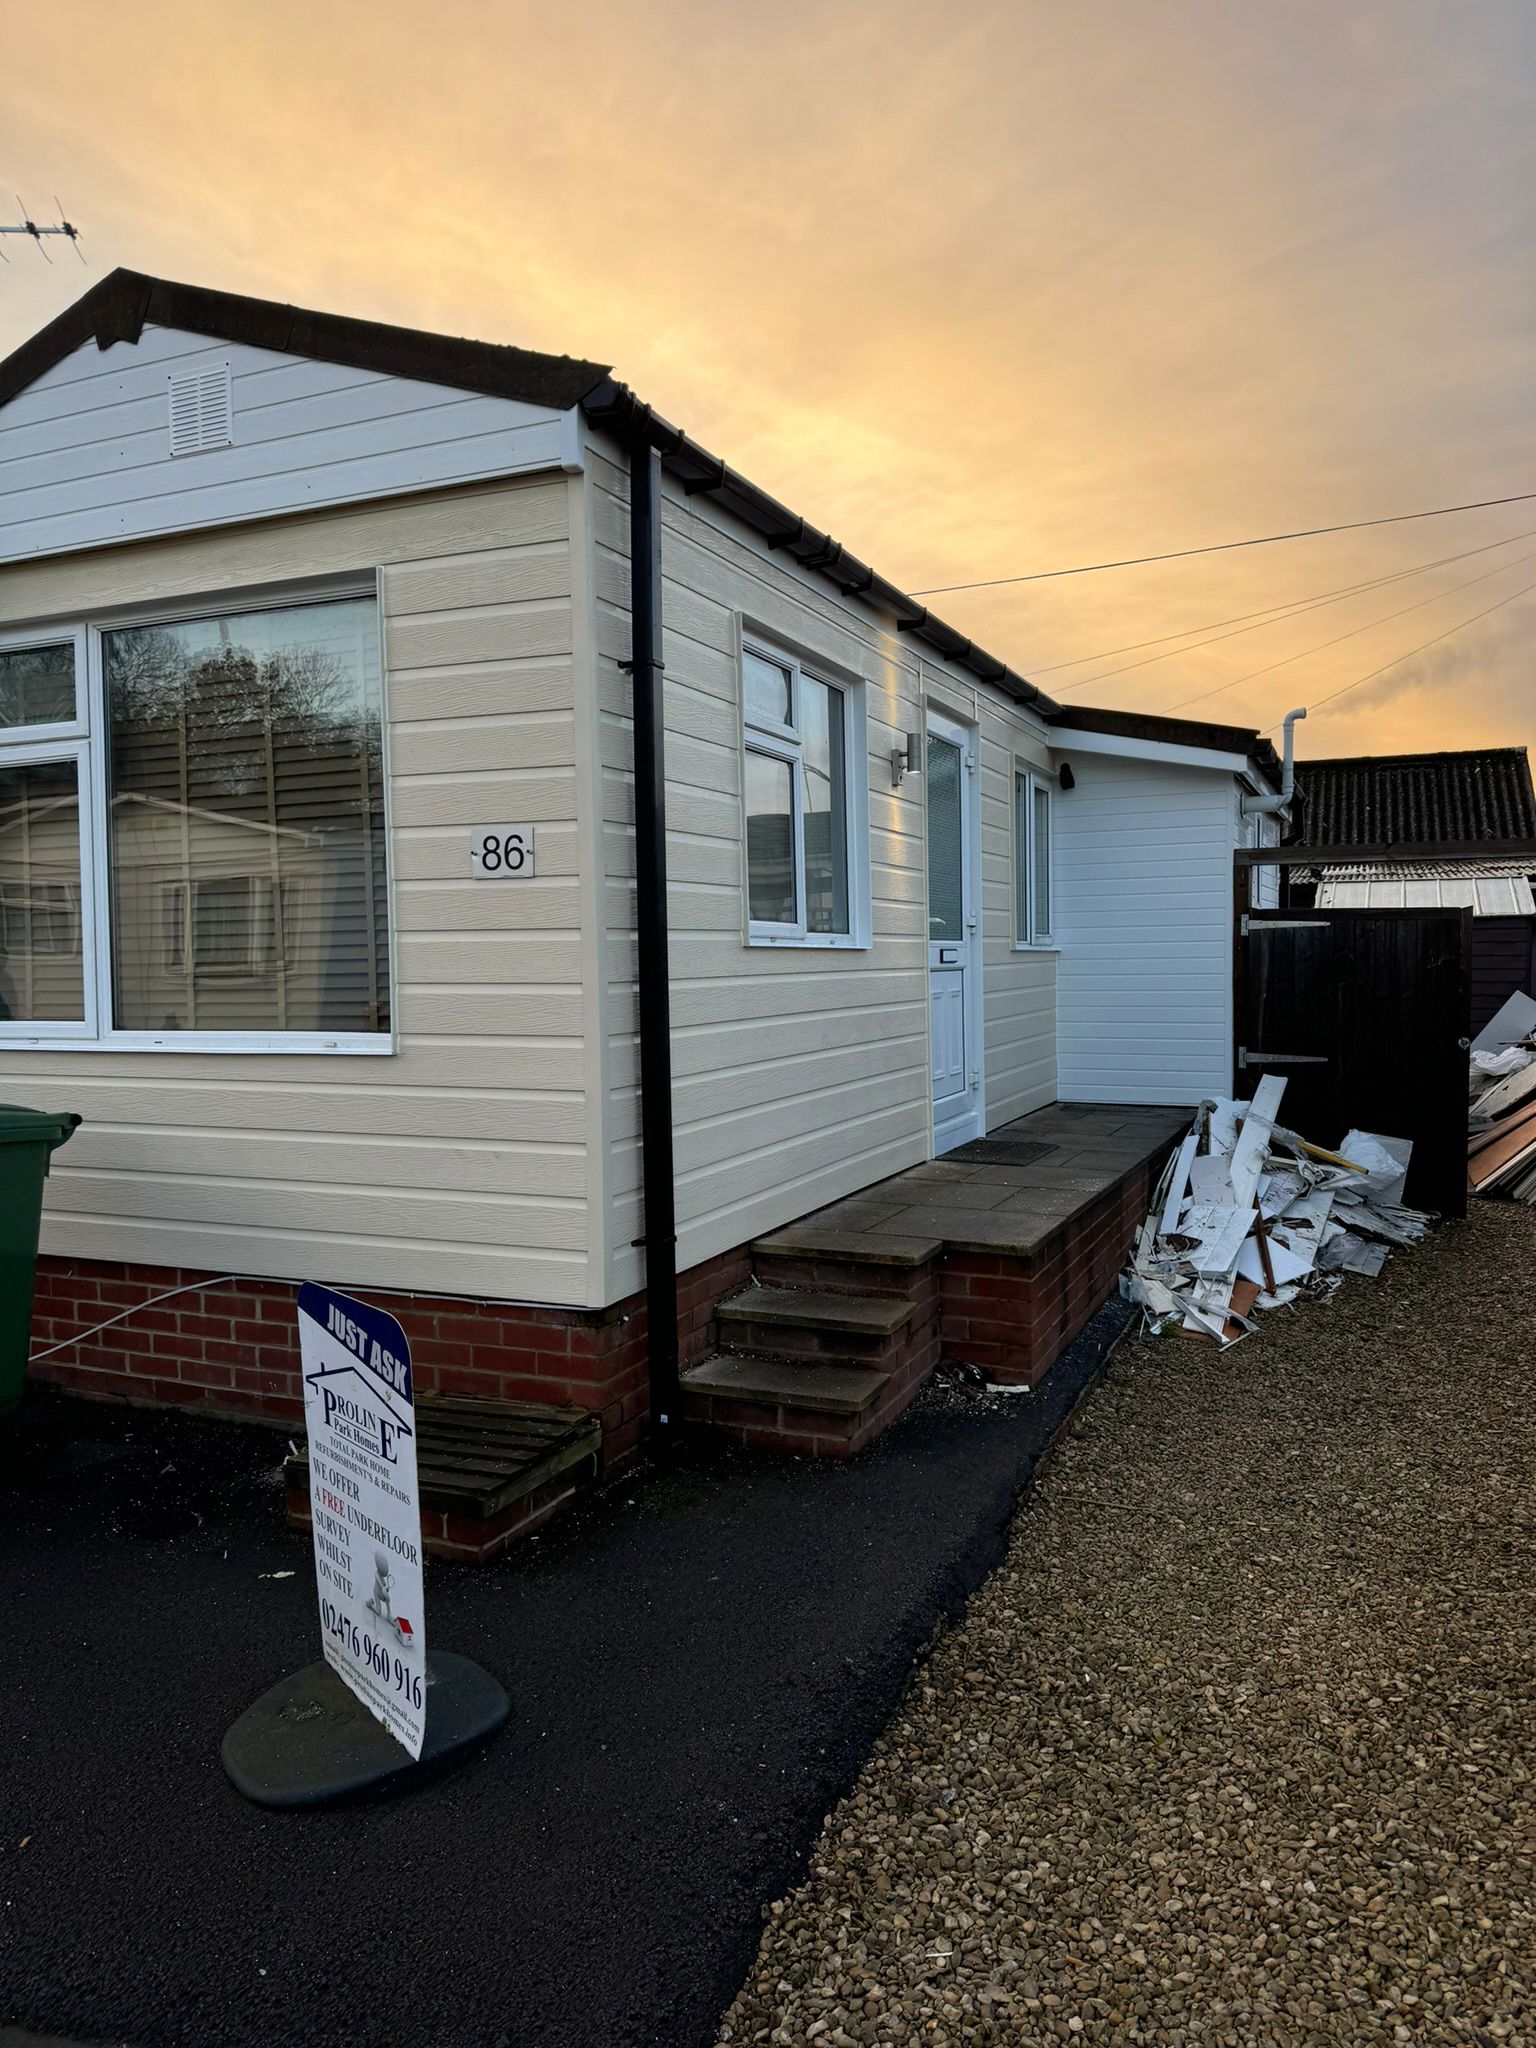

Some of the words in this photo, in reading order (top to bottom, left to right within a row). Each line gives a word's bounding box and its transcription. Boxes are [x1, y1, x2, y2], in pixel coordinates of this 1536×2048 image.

[482, 834, 524, 870] 86
[327, 1302, 368, 1359] JUST
[369, 1339, 408, 1396] ASK
[321, 1386, 397, 1465] PROLINE
[333, 1418, 352, 1440] Park
[353, 1428, 380, 1455] Homes
[329, 1435, 350, 1456] TOTAL
[351, 1448, 369, 1467] PARK
[313, 1457, 328, 1481] WE
[329, 1468, 360, 1502] OFFER
[374, 1476, 380, 1487] &
[381, 1479, 411, 1506] REPAIRS
[314, 1485, 321, 1502] A
[322, 1487, 346, 1518] FREE
[347, 1504, 418, 1567] UNDERFLOOR
[315, 1508, 351, 1546] SURVEY
[317, 1532, 353, 1573] WHILST
[319, 1559, 332, 1581] ON
[333, 1569, 354, 1599] SITE
[322, 1598, 360, 1657] 02476
[364, 1634, 390, 1682] 960
[394, 1658, 422, 1710] 916
